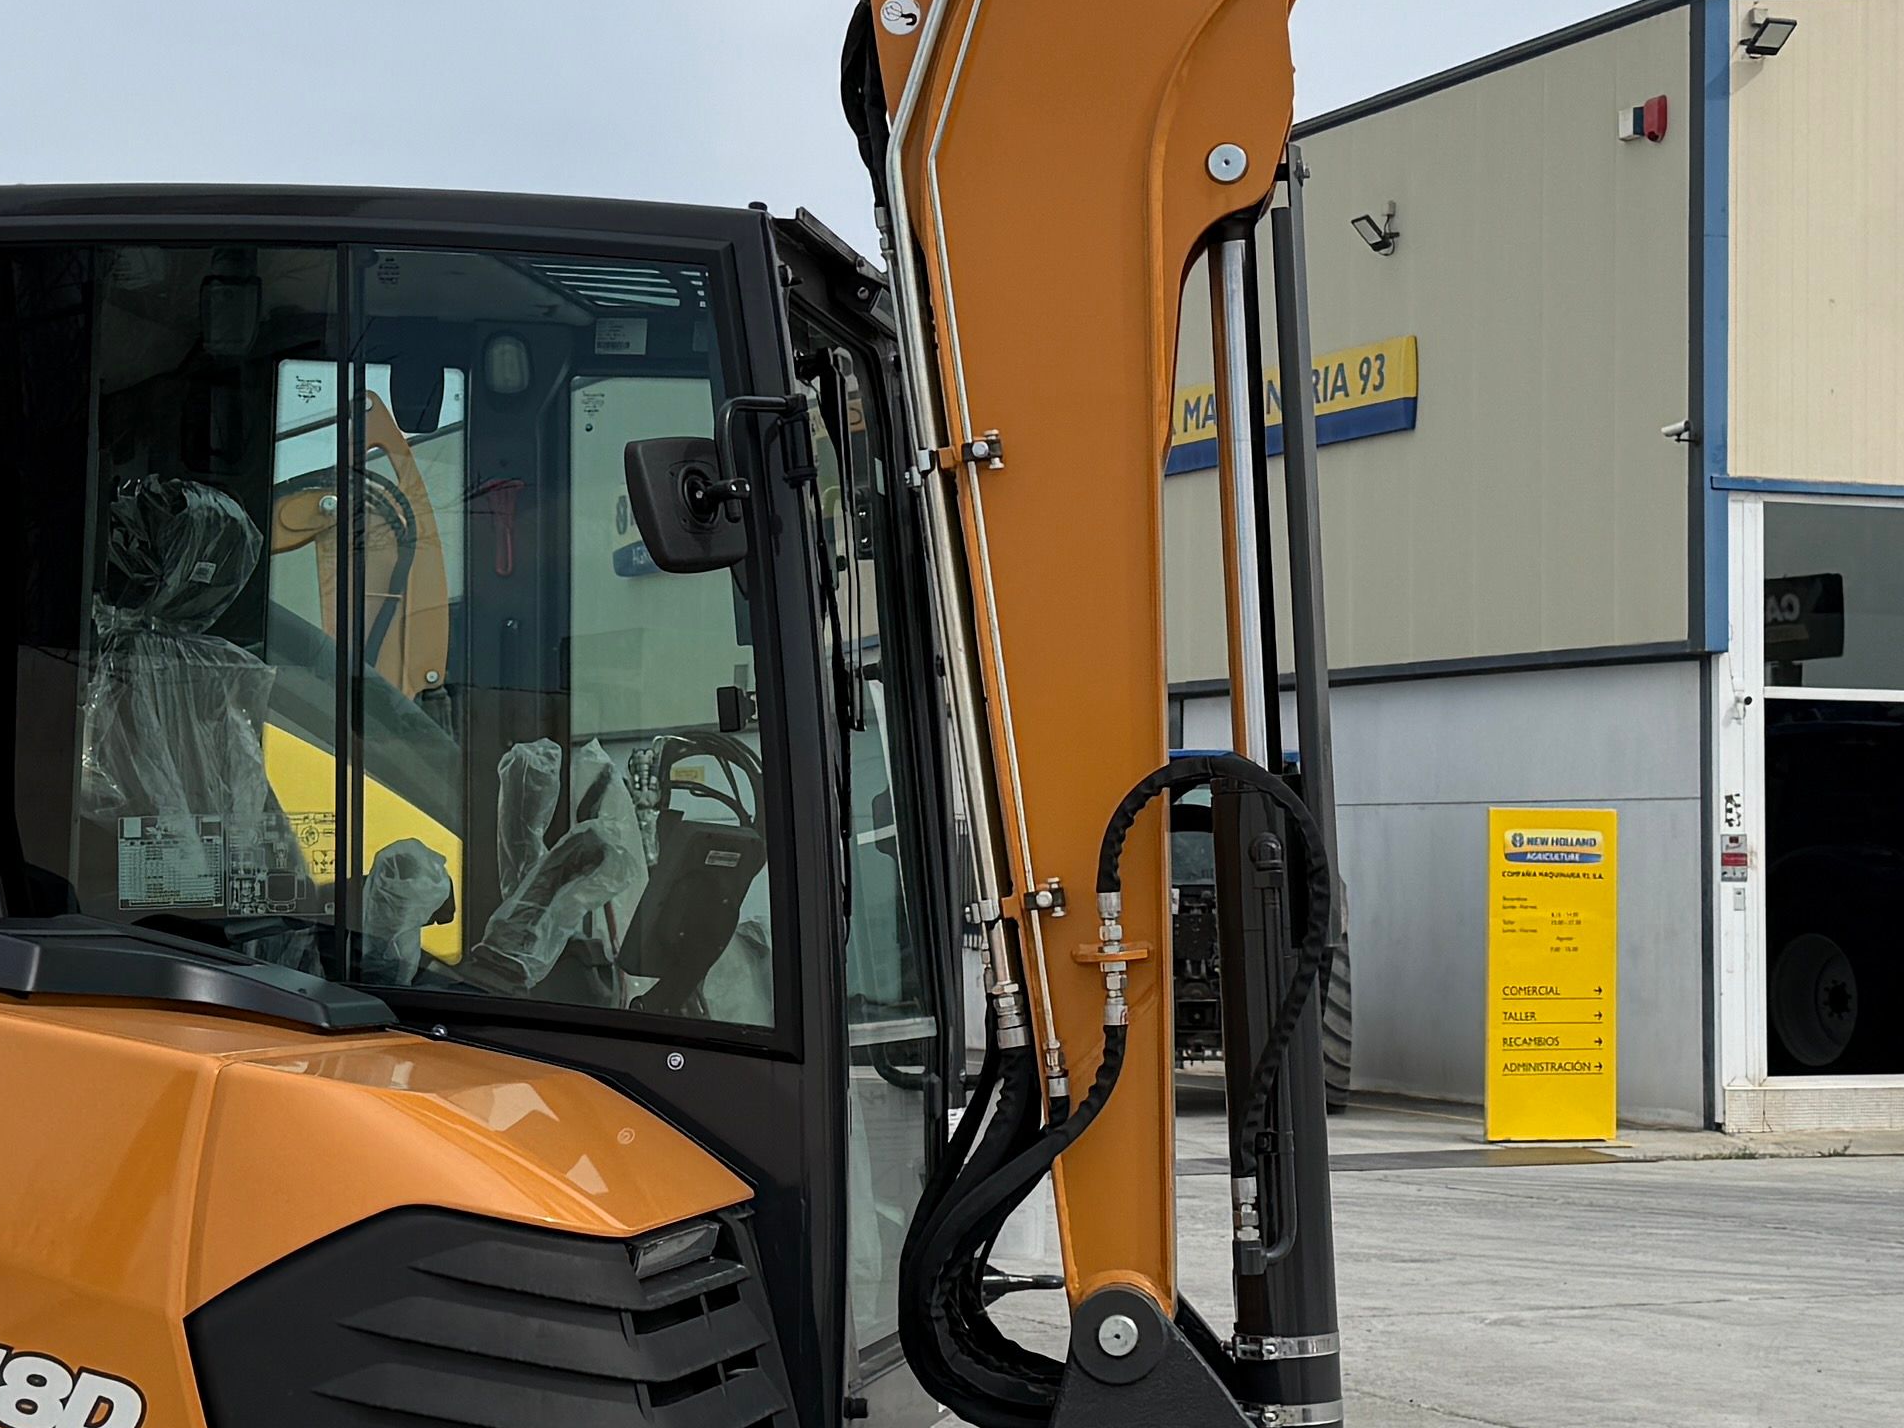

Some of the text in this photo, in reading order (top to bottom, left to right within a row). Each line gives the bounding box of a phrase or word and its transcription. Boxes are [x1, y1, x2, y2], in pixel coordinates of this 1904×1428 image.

[1358, 352, 1386, 395] 93
[1527, 836, 1597, 847] NEW HOLLAND
[1526, 852, 1580, 861] AGRICULTURE
[1502, 985, 1560, 996] COMERCIAL
[1502, 1011, 1537, 1021] TALLER
[1502, 1036, 1560, 1047] RECAMBIOS
[1502, 1060, 1591, 1072] ADMINISTRACIÓN
